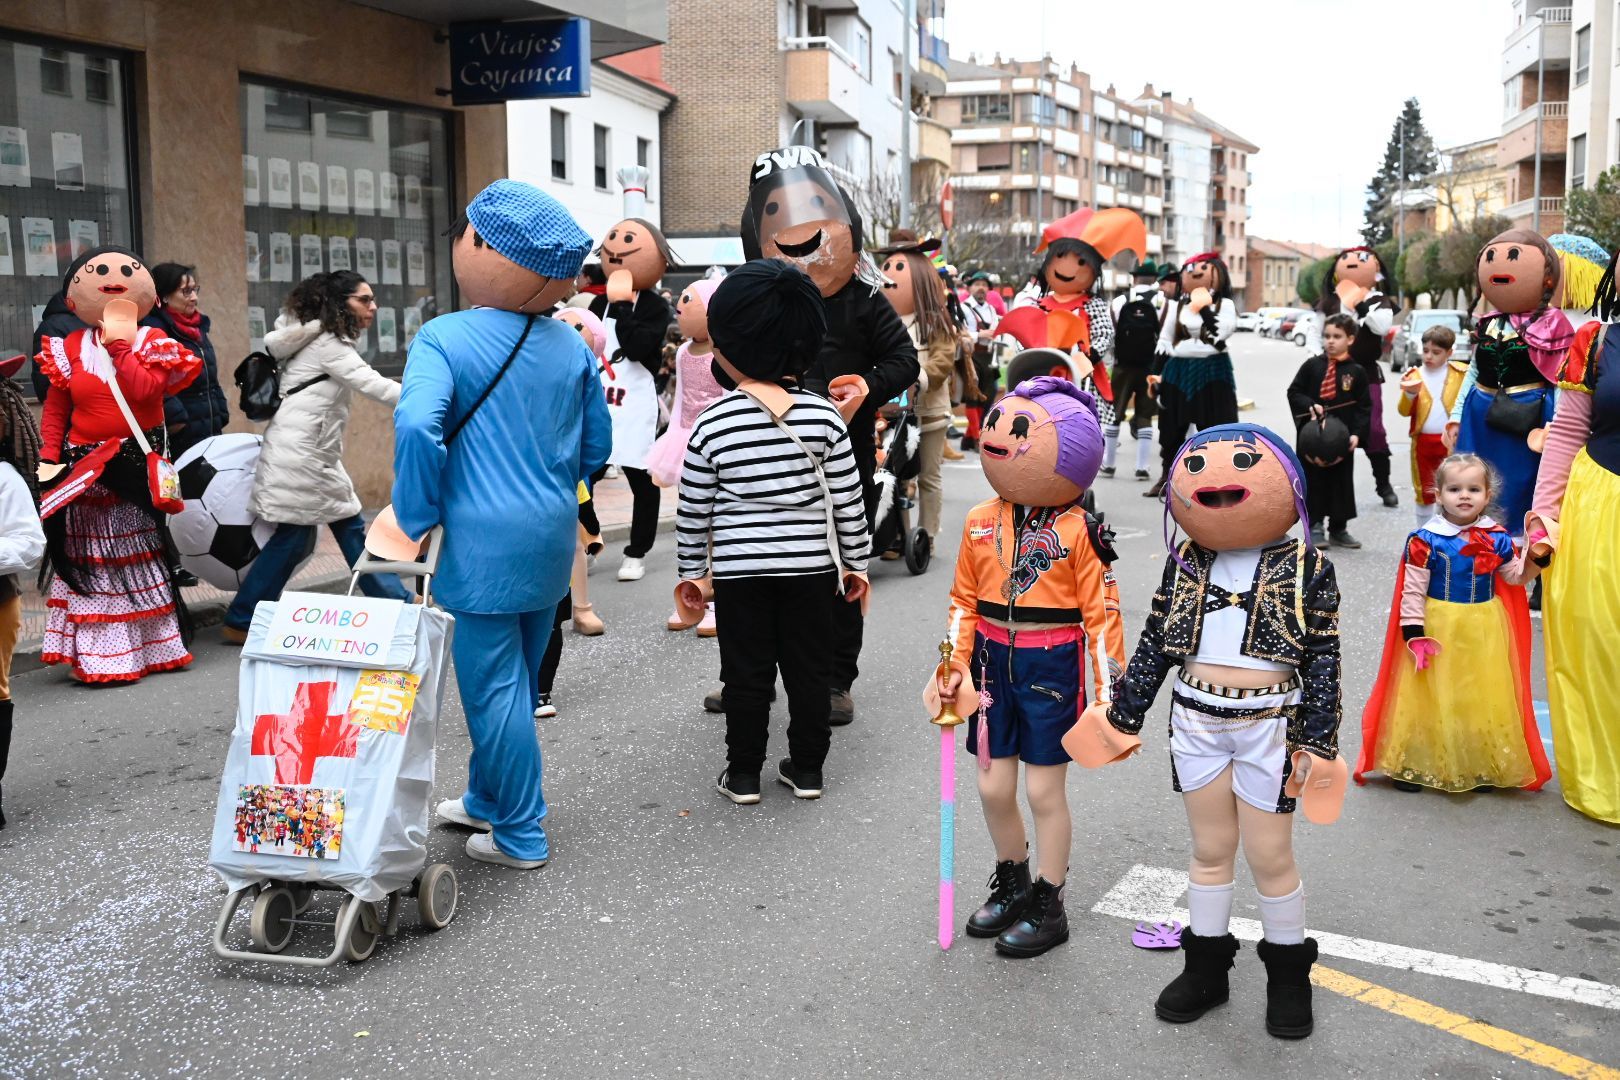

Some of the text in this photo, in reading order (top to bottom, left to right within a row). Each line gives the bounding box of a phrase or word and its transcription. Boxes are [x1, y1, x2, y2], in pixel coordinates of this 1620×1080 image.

[469, 30, 562, 60] Viajes
[460, 61, 573, 93] Coyança
[292, 607, 369, 628] COMBO
[273, 634, 379, 656] COYANTINO
[351, 684, 404, 717] 25
